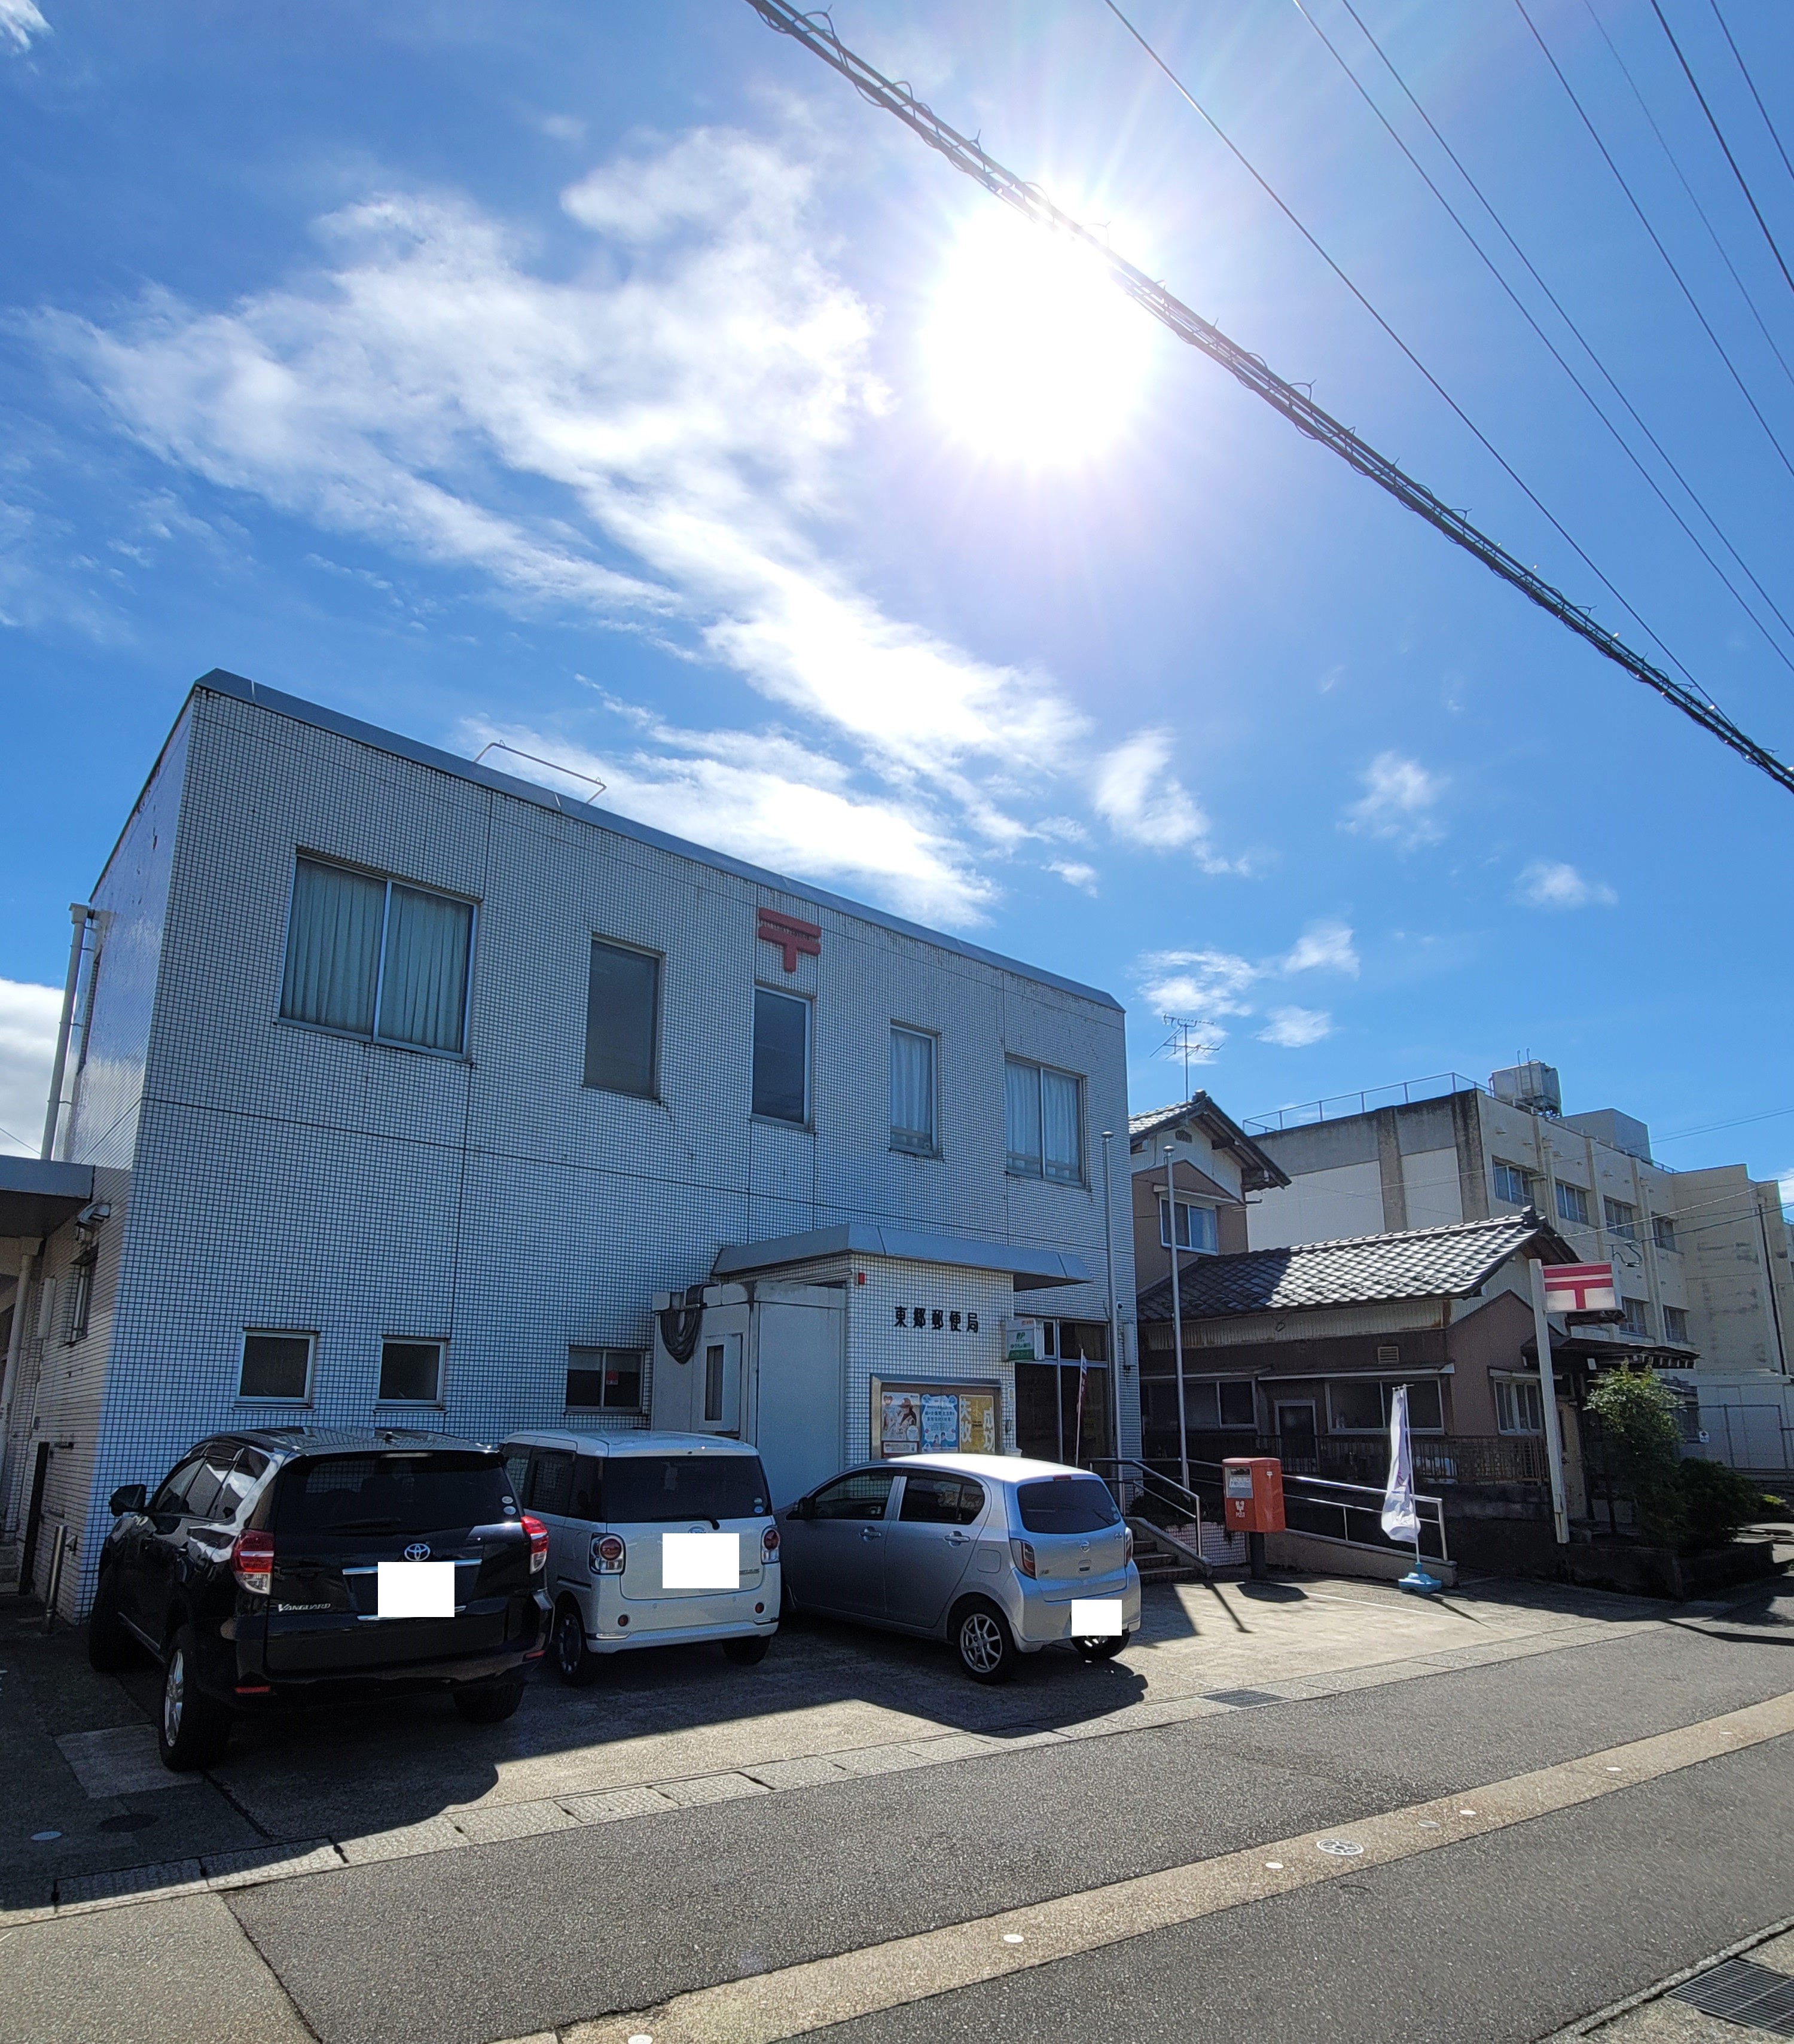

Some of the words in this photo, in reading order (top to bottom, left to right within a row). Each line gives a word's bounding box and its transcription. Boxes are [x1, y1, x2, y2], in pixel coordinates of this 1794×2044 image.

[894, 1305, 979, 1333] 東郷郵便局
[278, 1603, 331, 1612] VANGUARD
